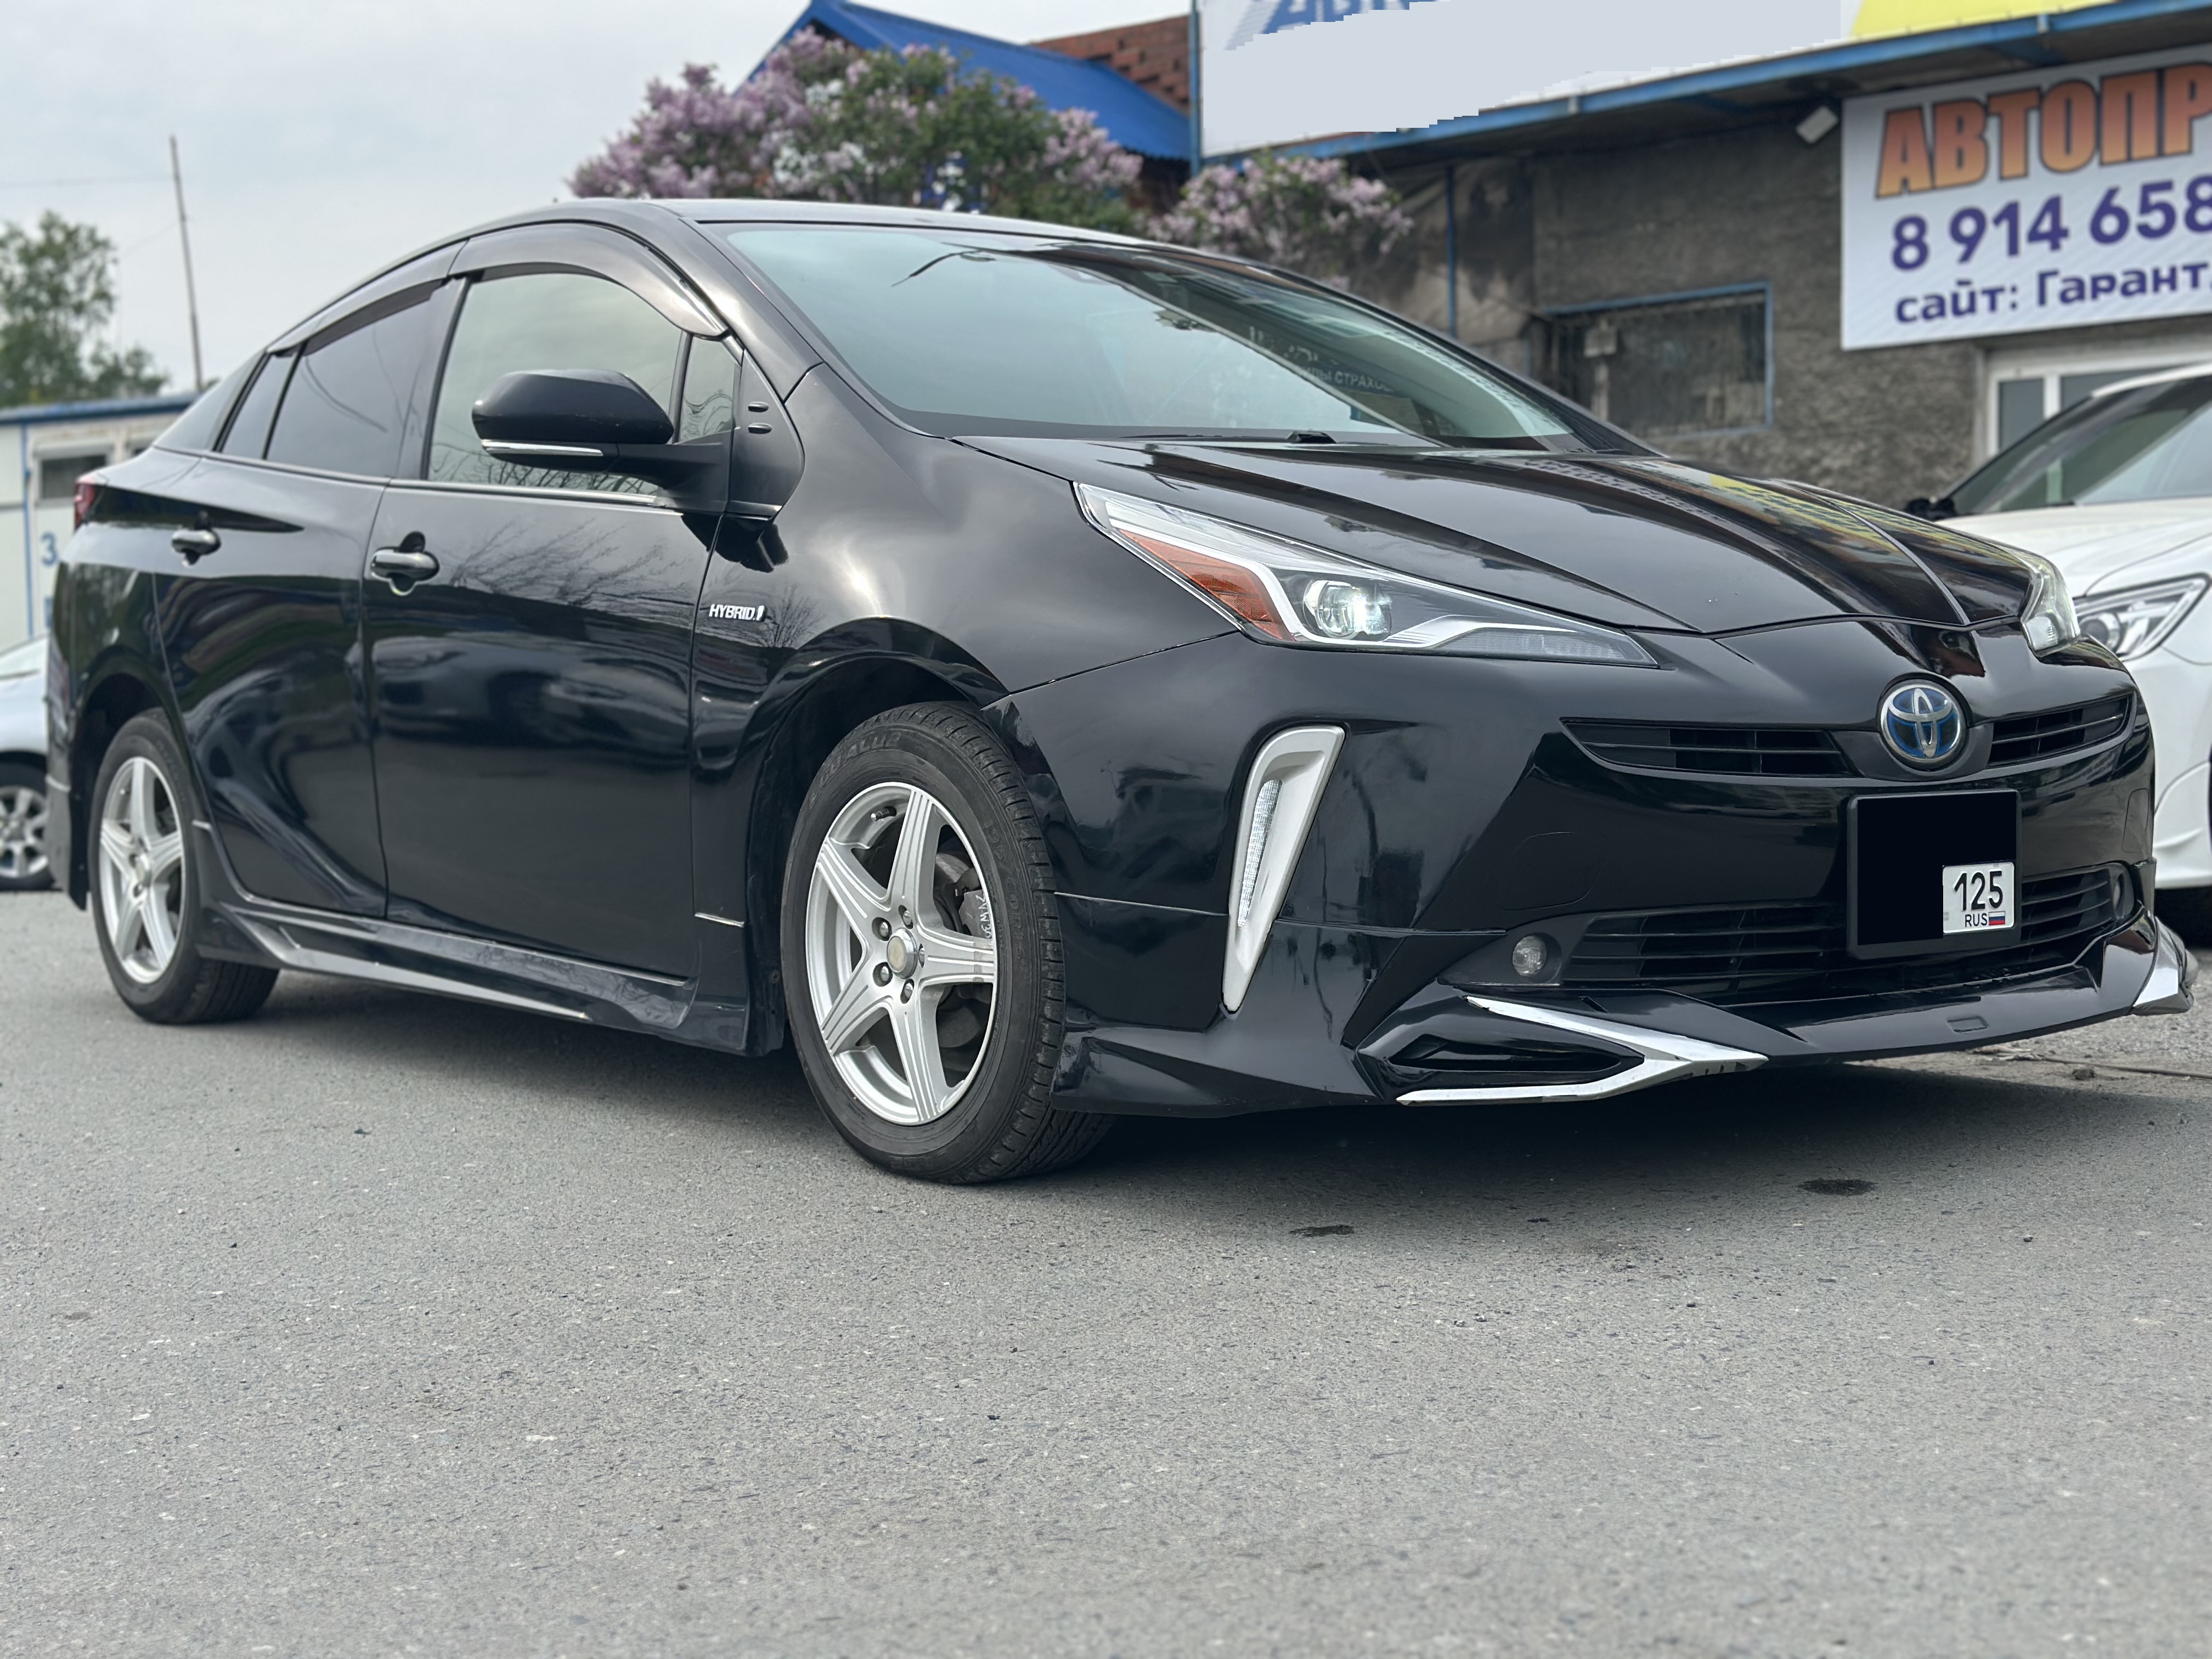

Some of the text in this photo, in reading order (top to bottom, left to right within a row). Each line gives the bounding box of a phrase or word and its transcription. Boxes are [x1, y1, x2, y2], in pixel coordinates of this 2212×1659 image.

[1891, 174, 2212, 272] 8 914 658
[1895, 262, 2212, 324] сайт: Гарант
[1334, 370, 1394, 392] СТРАХО
[1953, 870, 2004, 912] 125
[1964, 912, 1988, 928] RUS
